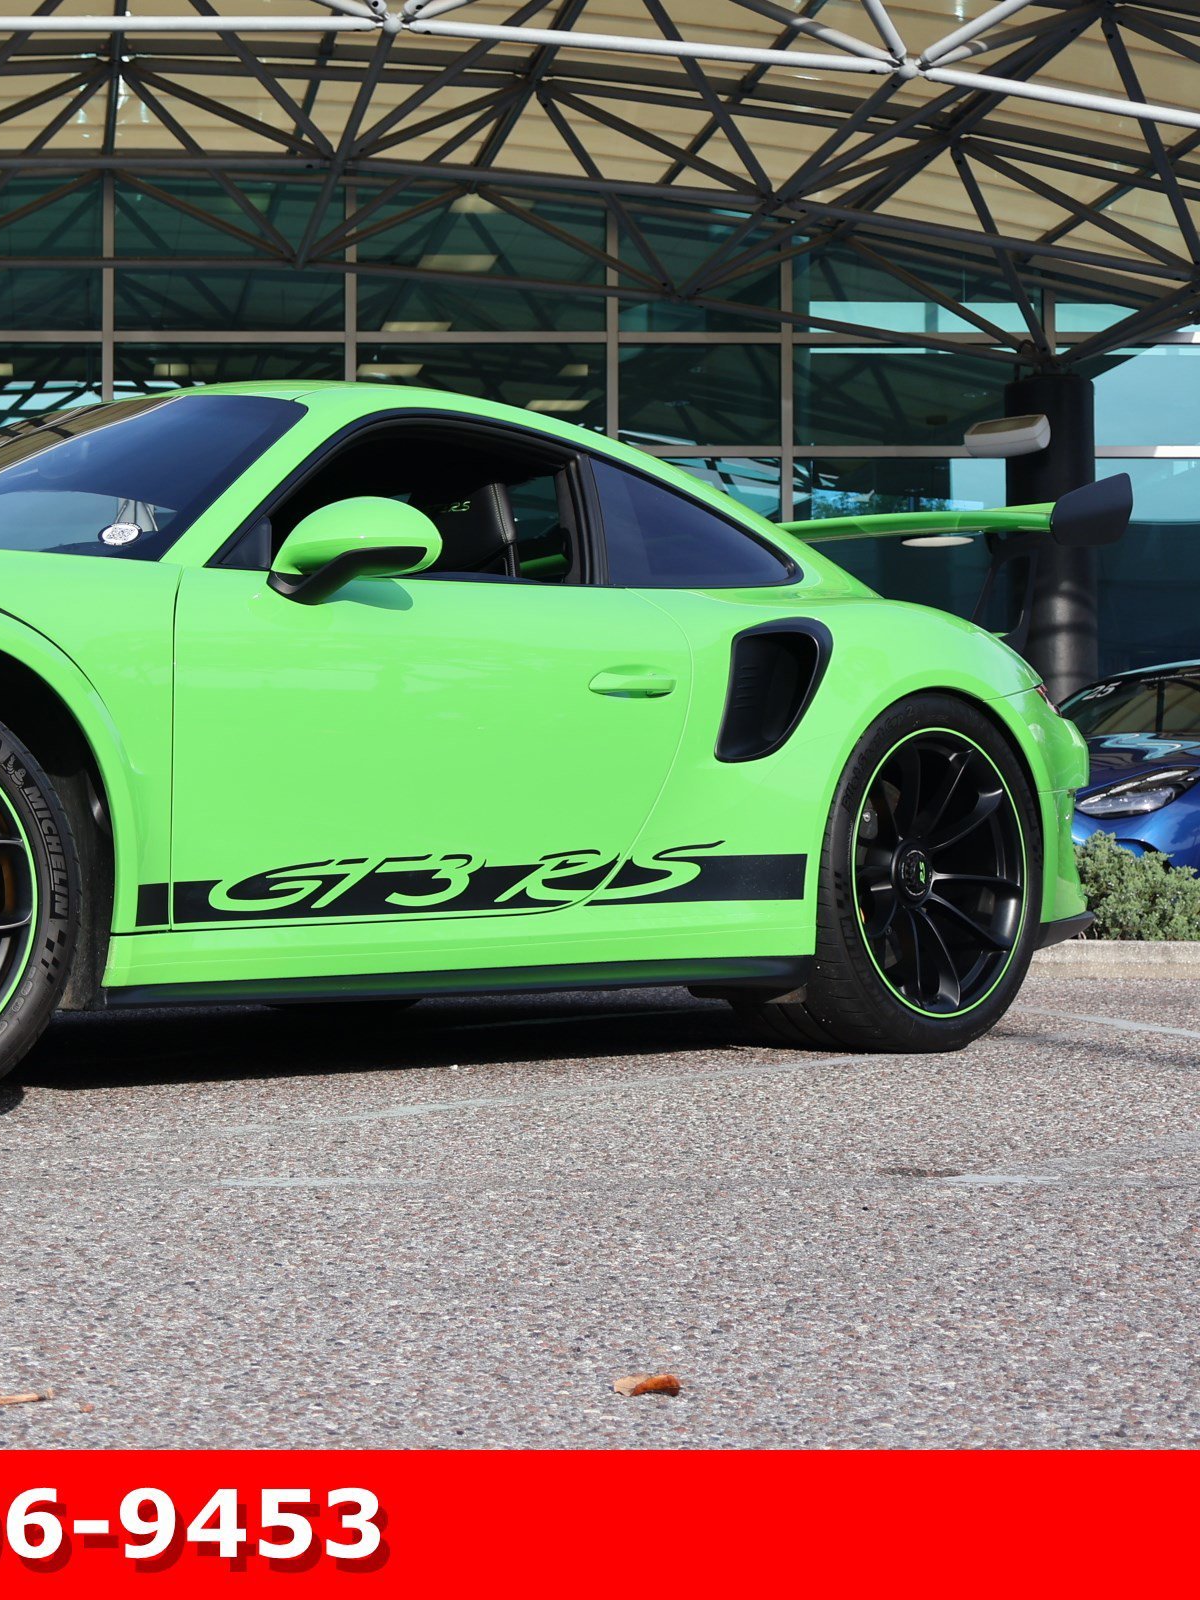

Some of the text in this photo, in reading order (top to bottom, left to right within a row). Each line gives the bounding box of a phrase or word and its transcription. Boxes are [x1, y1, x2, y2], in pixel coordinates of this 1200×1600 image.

[1081, 681, 1122, 700] 25
[23, 786, 68, 919] MICHELIN
[207, 840, 726, 912] GT3 RS
